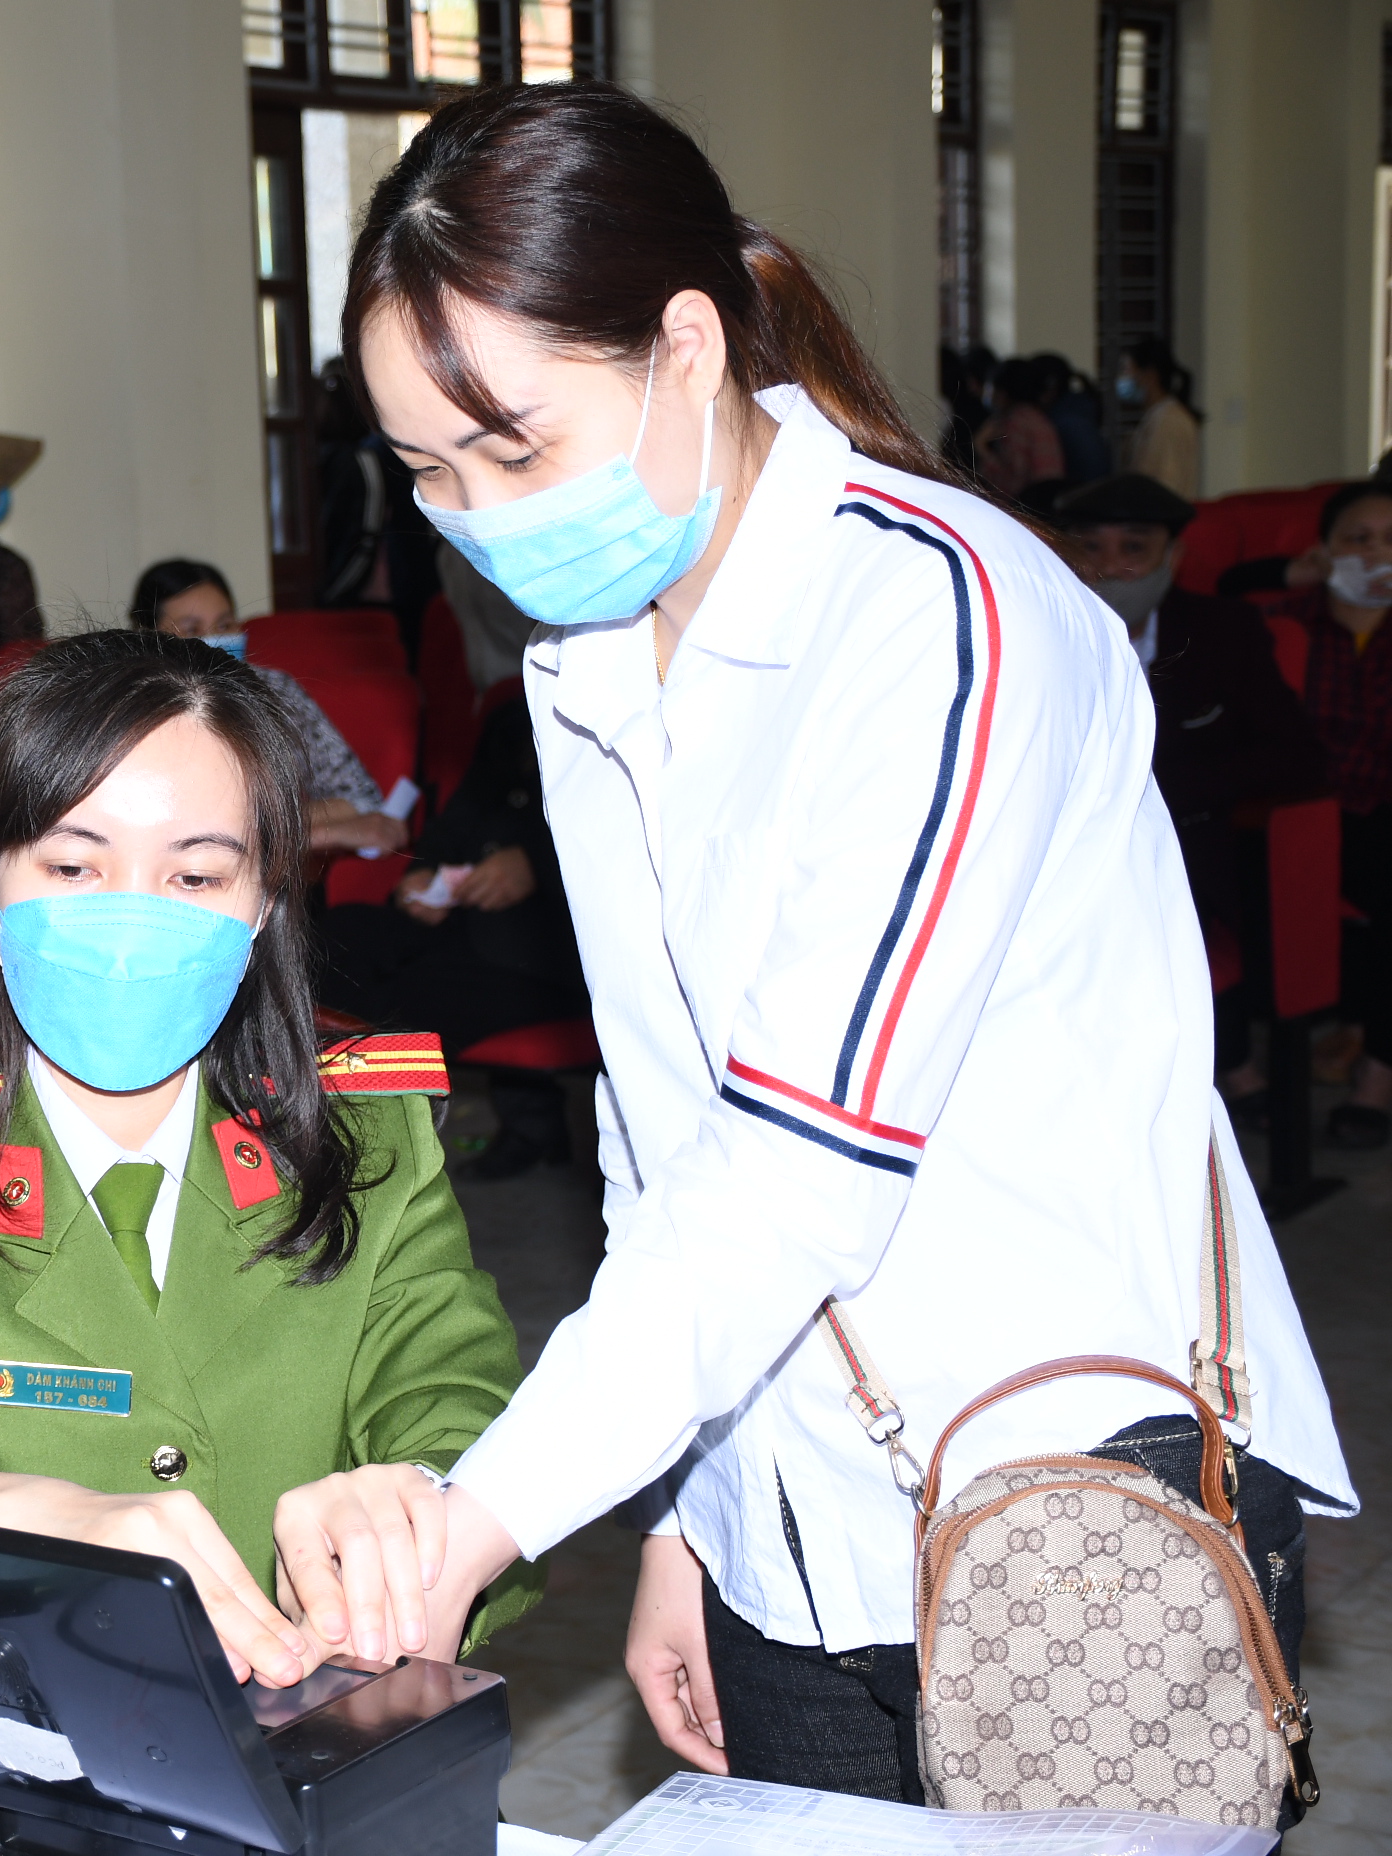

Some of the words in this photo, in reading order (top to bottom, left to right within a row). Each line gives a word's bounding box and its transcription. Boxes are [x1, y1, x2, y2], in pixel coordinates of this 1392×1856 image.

[54, 1373, 95, 1390] KHÁNH
[97, 1379, 116, 1393] CHI
[34, 1391, 64, 1405] 157
[77, 1394, 108, 1408] 684
